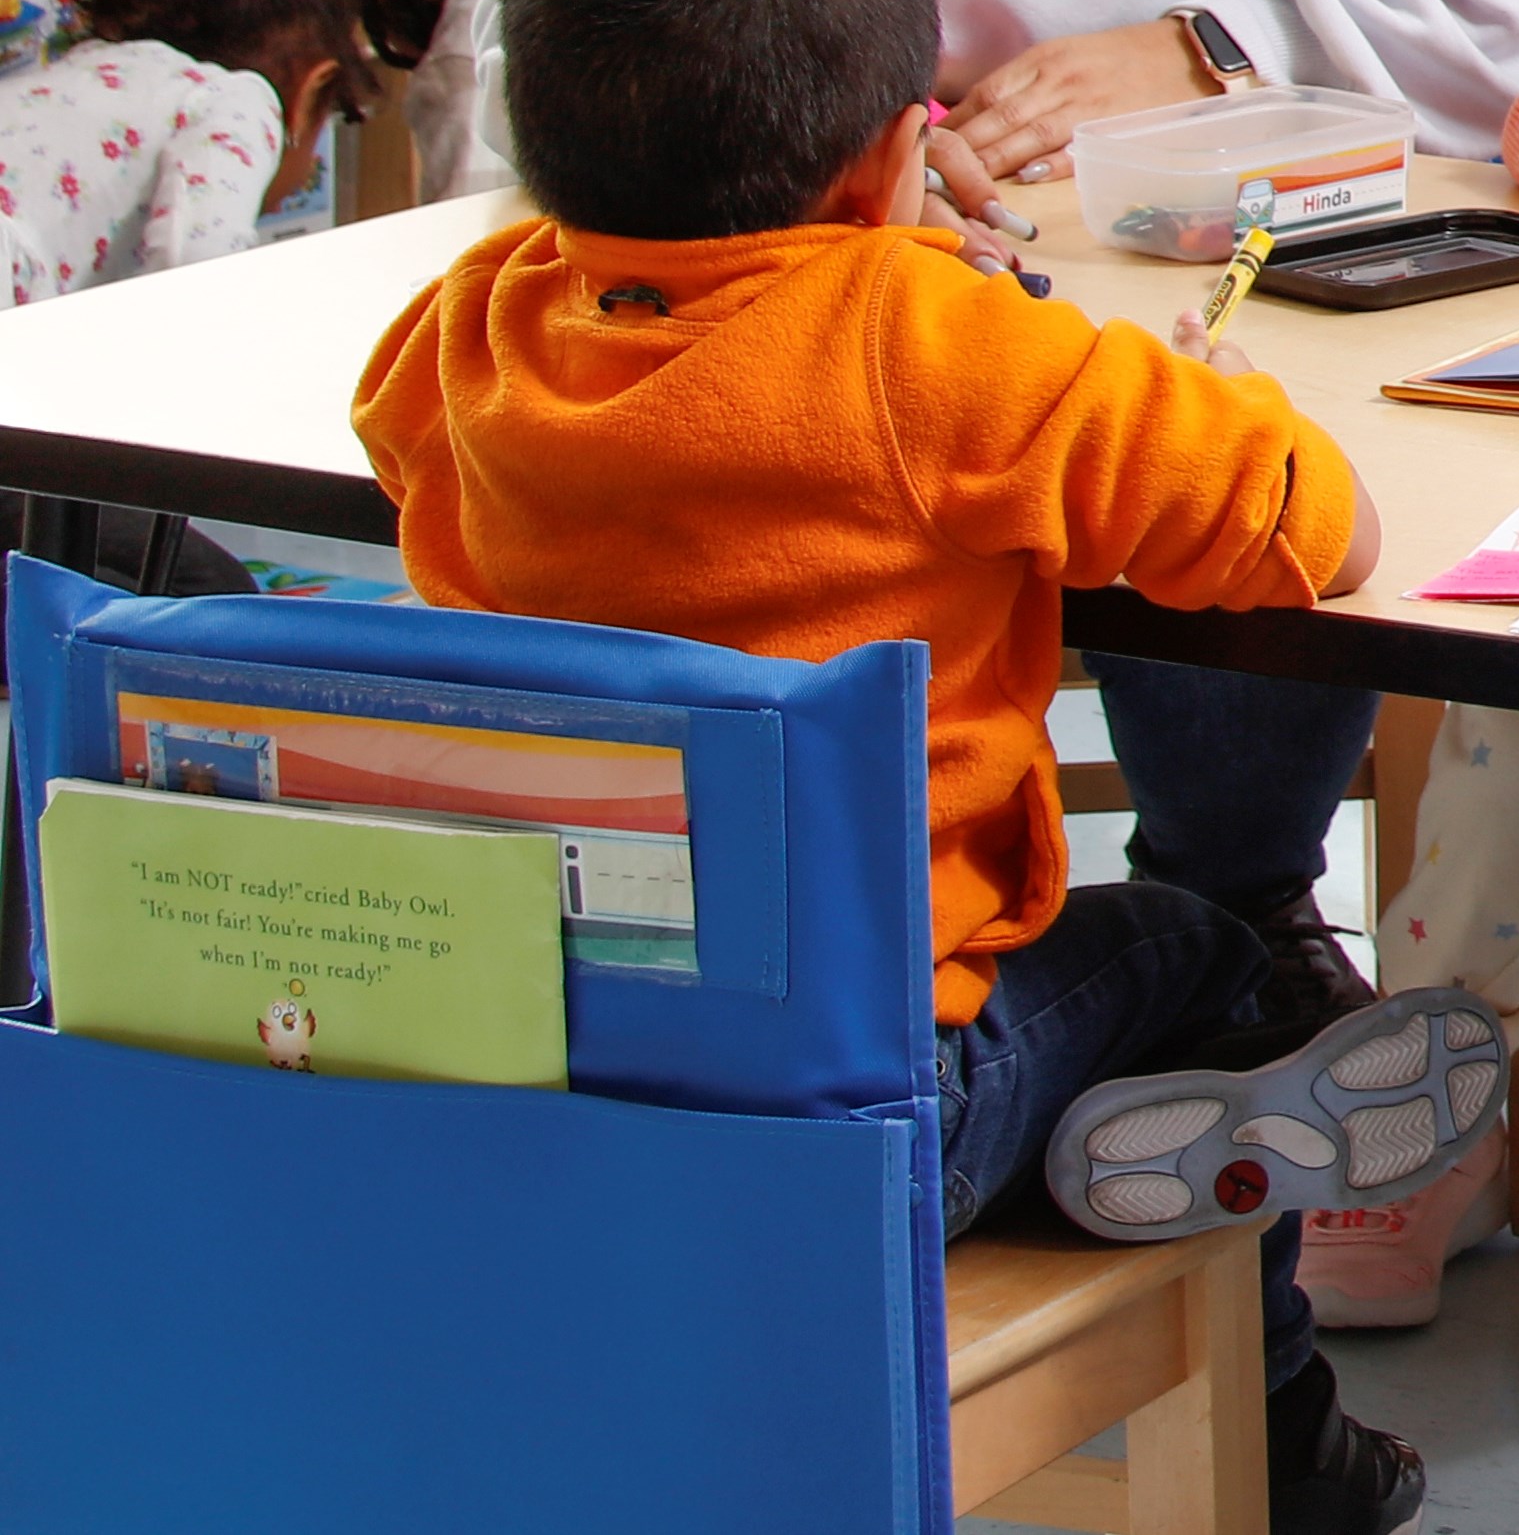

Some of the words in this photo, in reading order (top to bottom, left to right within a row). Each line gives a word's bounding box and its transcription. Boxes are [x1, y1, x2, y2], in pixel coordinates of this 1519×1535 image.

[1303, 188, 1352, 215] Hinda
[1200, 277, 1233, 328] rayola
[155, 870, 180, 885] am
[187, 869, 233, 892] NOT
[304, 886, 350, 906] cried
[358, 889, 402, 916] Baby
[409, 896, 455, 917] Owl.
[564, 844, 583, 915] i
[182, 909, 209, 925] not
[216, 908, 252, 931] fair!
[257, 915, 313, 939] You're
[321, 924, 391, 952] making
[396, 935, 423, 951] me
[429, 941, 452, 959] go
[200, 944, 245, 966] when
[253, 950, 281, 971] I'm
[289, 960, 319, 977] not
[327, 961, 391, 987] ready!"
